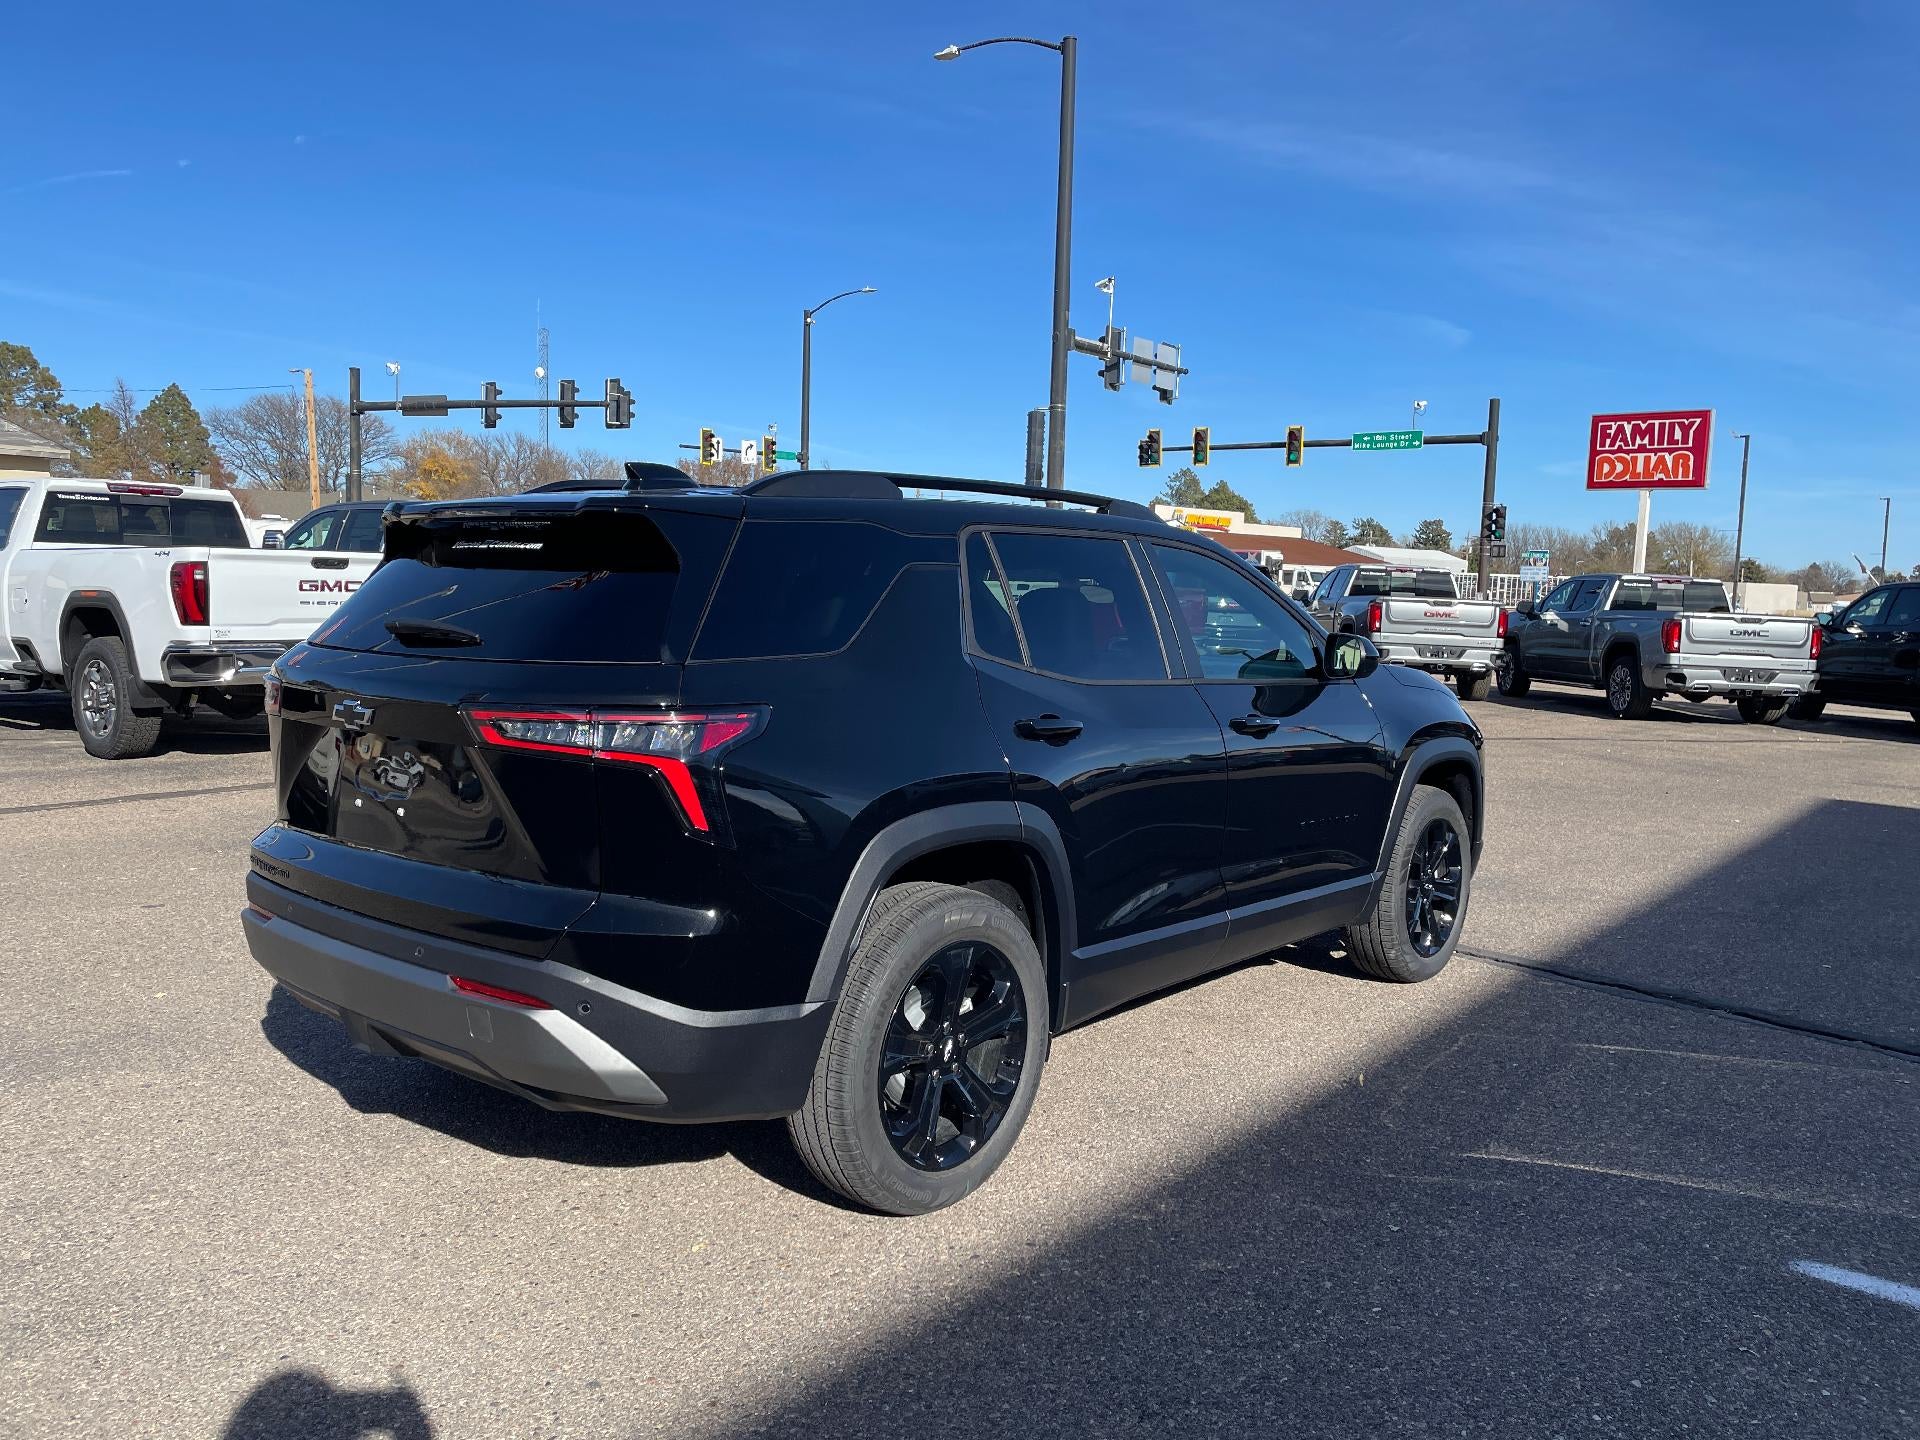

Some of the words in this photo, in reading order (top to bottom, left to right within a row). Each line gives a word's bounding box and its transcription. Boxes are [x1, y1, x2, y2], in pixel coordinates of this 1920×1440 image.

[1597, 418, 1702, 450] FAMILY
[1594, 450, 1694, 482] DOLLAR
[299, 580, 362, 592] GMC
[1424, 610, 1459, 619] GMC
[1729, 629, 1770, 638] GMC
